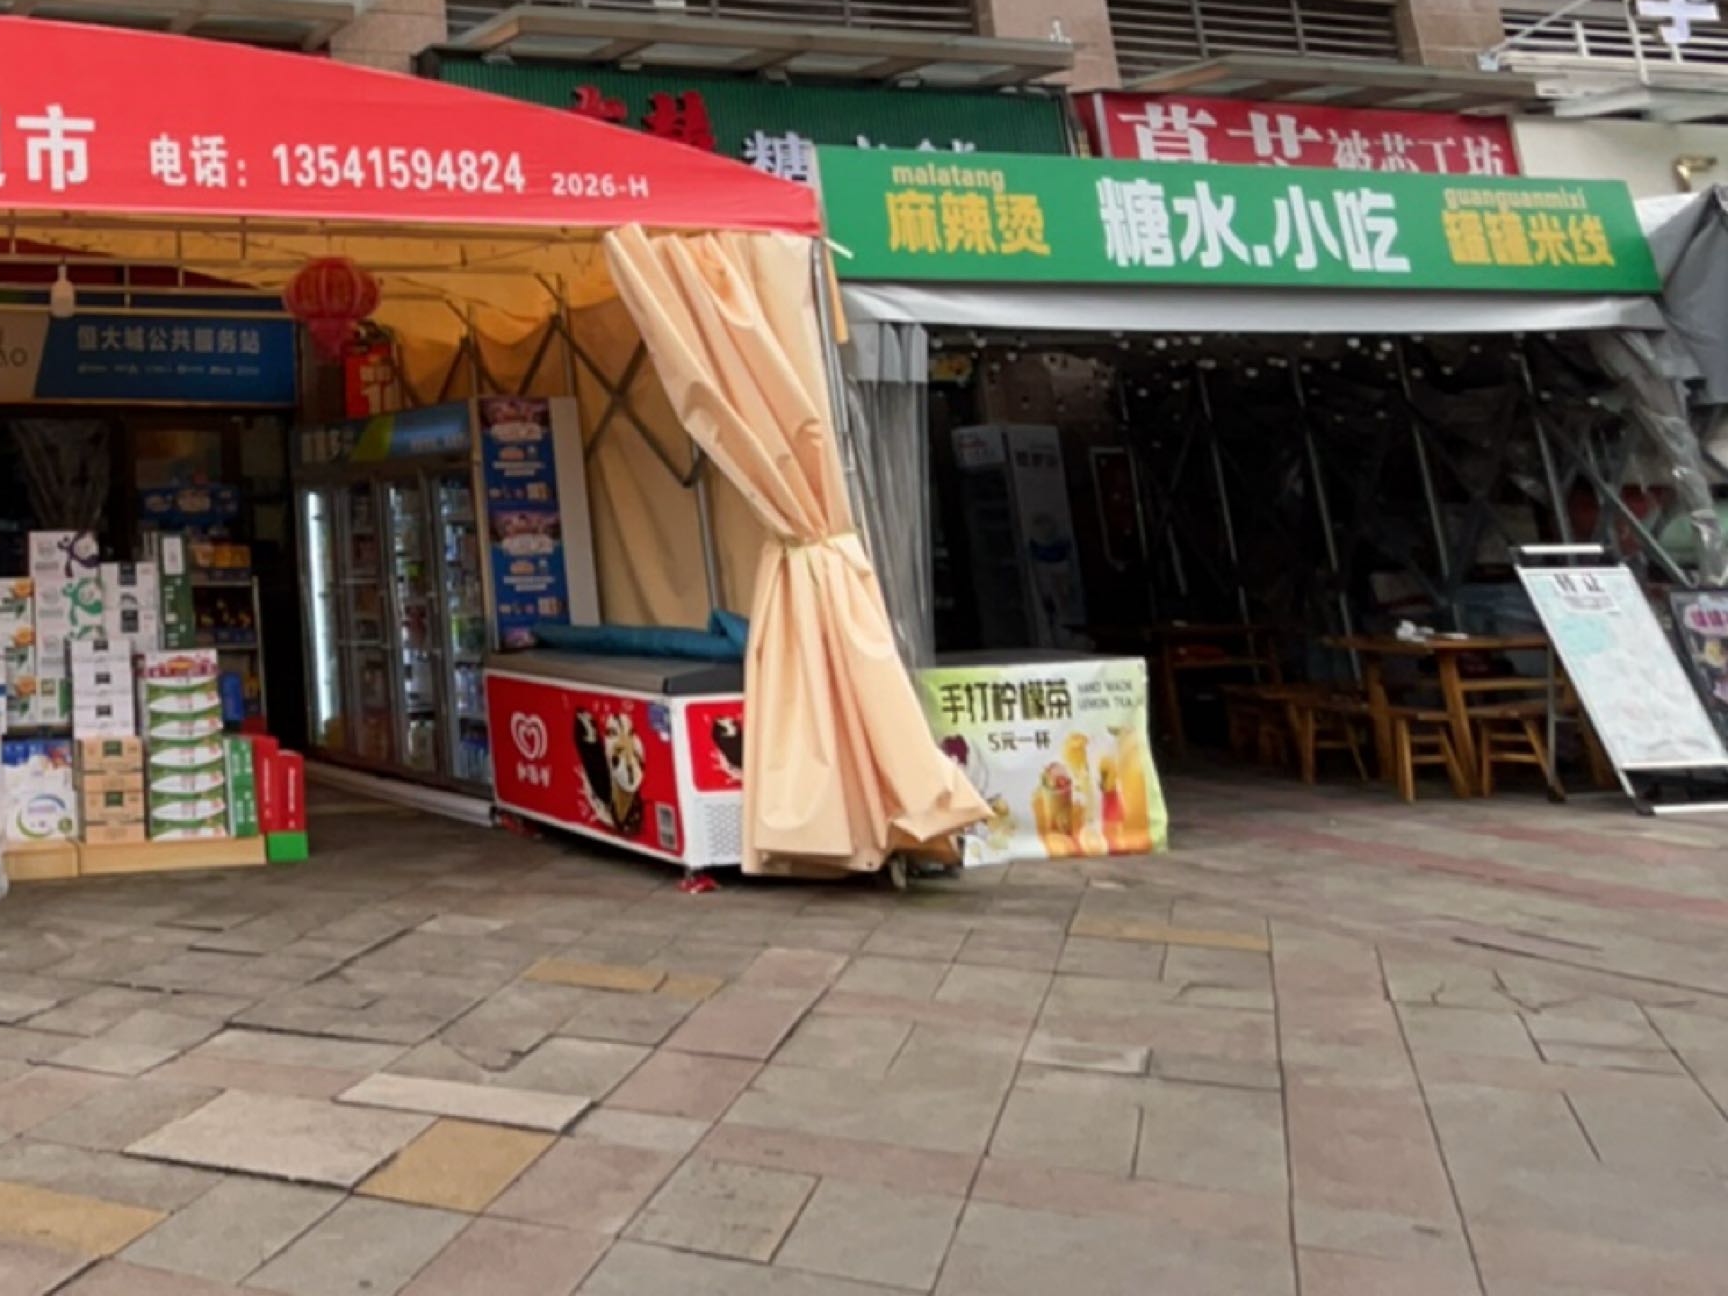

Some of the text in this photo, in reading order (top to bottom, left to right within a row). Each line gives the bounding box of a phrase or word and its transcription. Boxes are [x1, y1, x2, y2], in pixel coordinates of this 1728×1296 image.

[270, 143, 526, 194] 13541594824
[550, 171, 650, 199] 2026-H
[891, 161, 1006, 192] malatang
[884, 190, 1052, 256] 麻辣烫
[938, 678, 1073, 723] 手打柠檬茶
